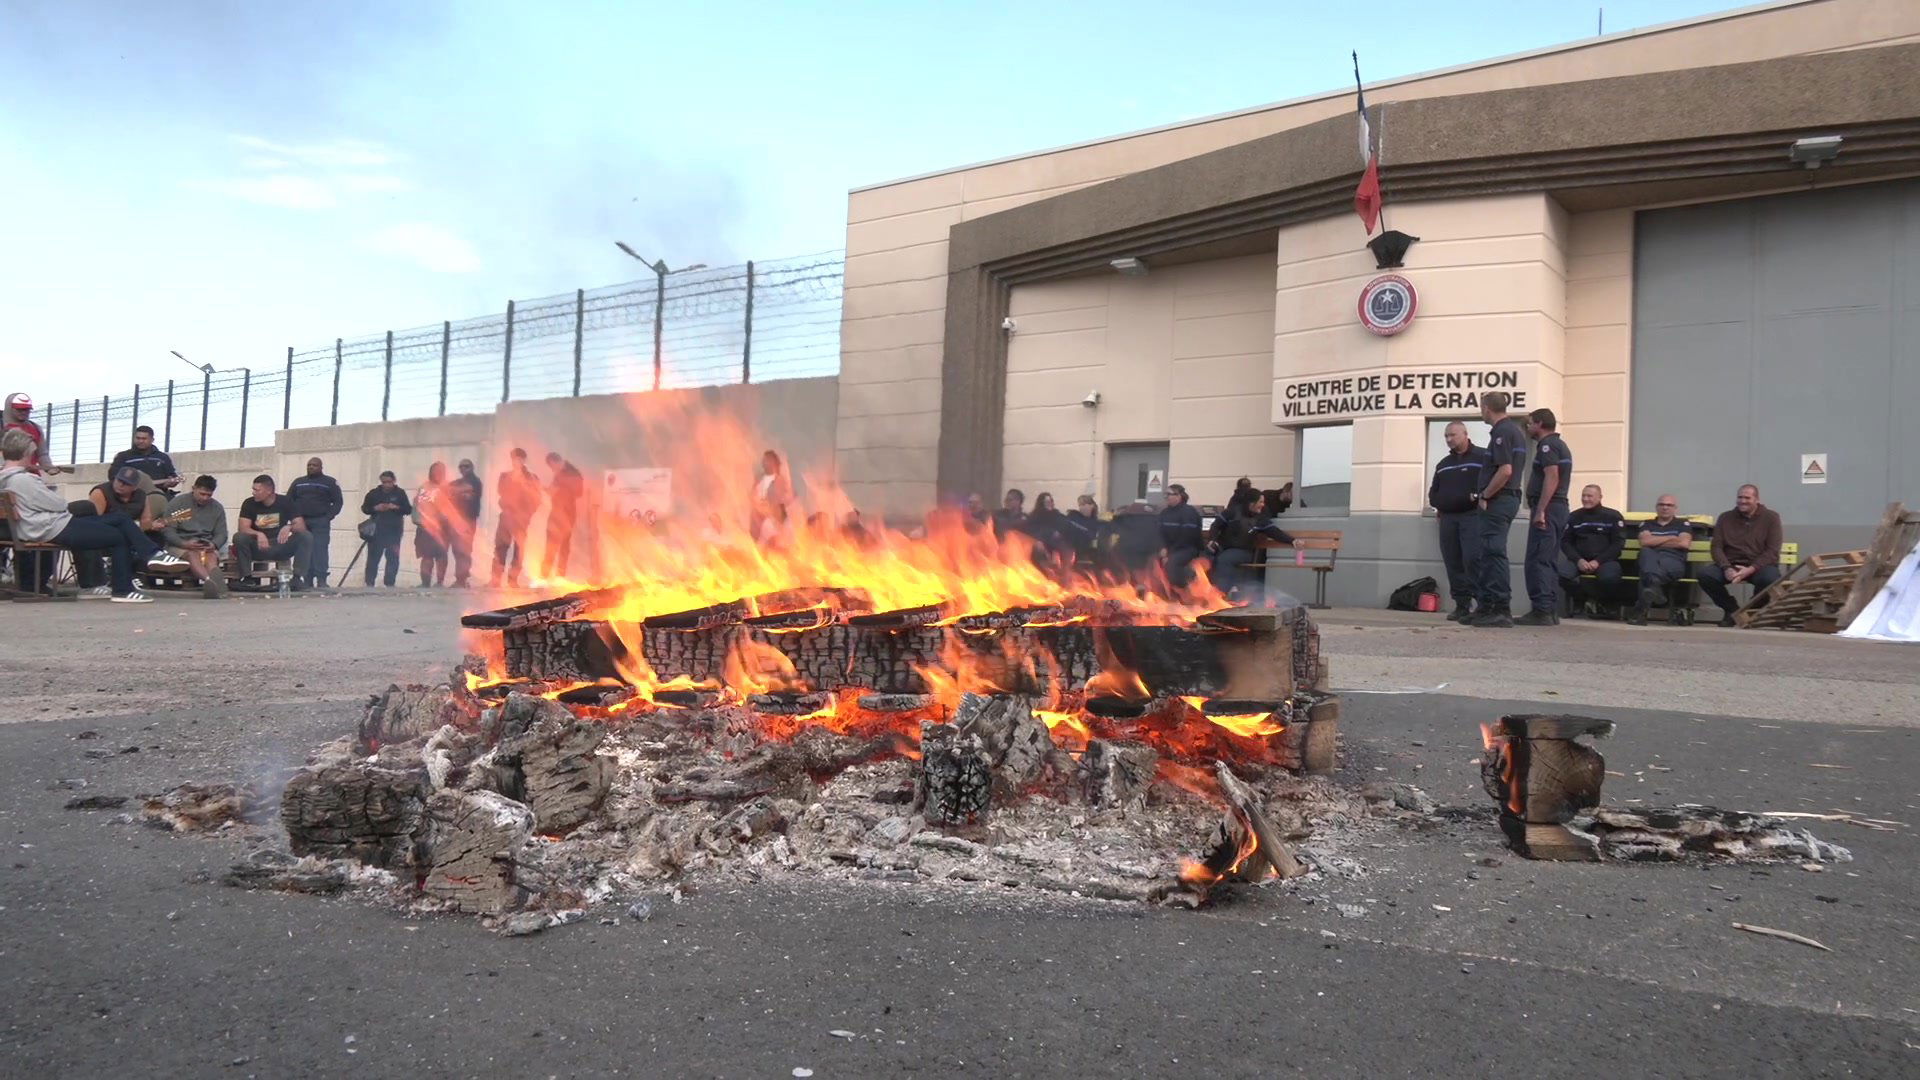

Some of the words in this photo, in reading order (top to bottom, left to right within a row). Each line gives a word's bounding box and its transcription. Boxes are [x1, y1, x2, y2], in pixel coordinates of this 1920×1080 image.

[1286, 378, 1353, 399] CENTRE
[1358, 375, 1381, 392] DE
[1387, 371, 1518, 390] DETENTION
[1282, 394, 1385, 417] VILLENAUXE
[1394, 393, 1422, 409] LA
[1431, 391, 1526, 409] GRADE
